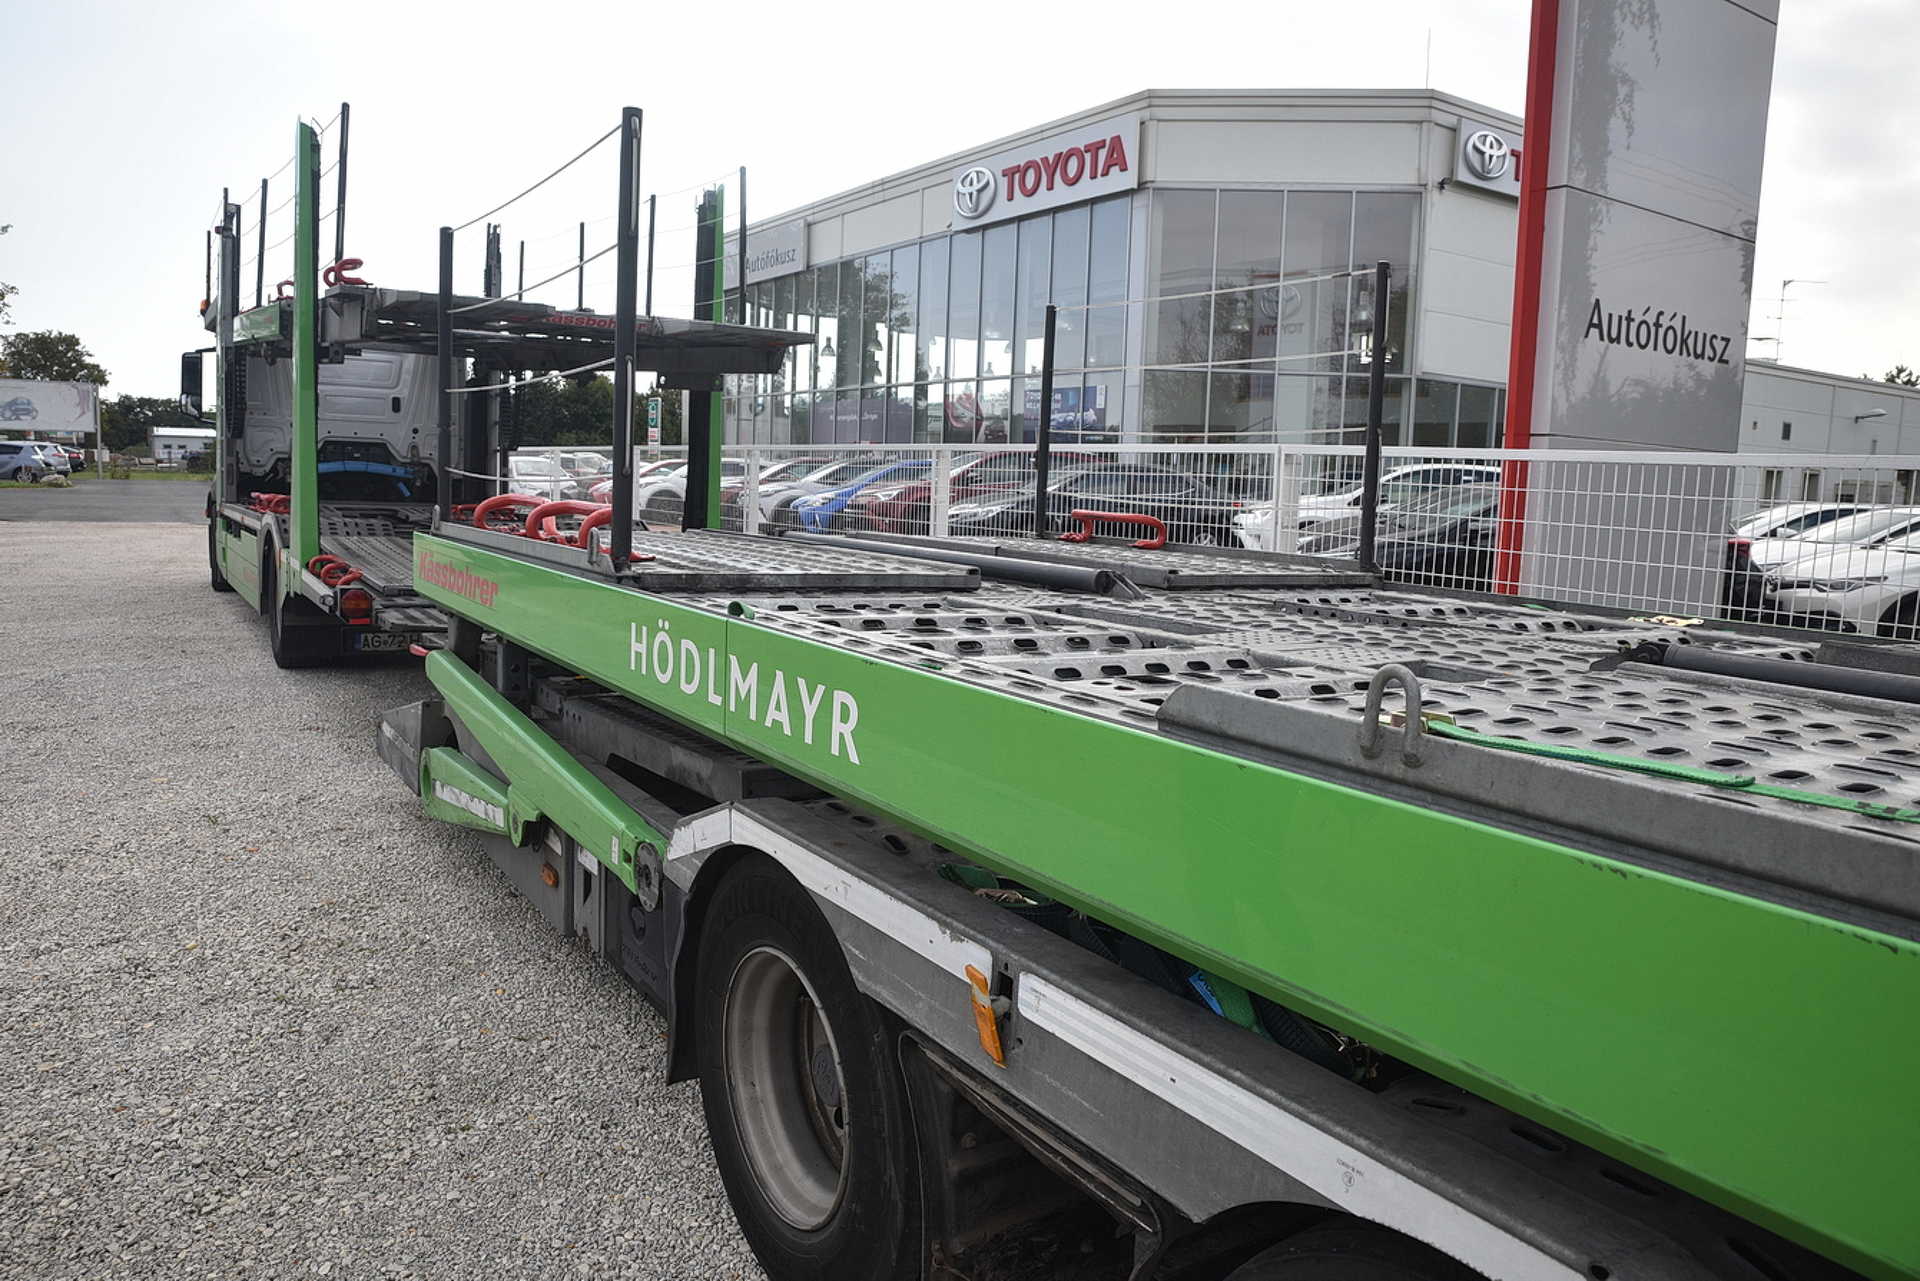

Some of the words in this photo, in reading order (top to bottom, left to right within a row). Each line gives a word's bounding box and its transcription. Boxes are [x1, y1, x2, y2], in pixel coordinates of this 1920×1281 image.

[1001, 134, 1129, 202] TOYOTA
[1584, 297, 1732, 366] Autófókusz
[629, 617, 861, 766] HÖDLMAYR
